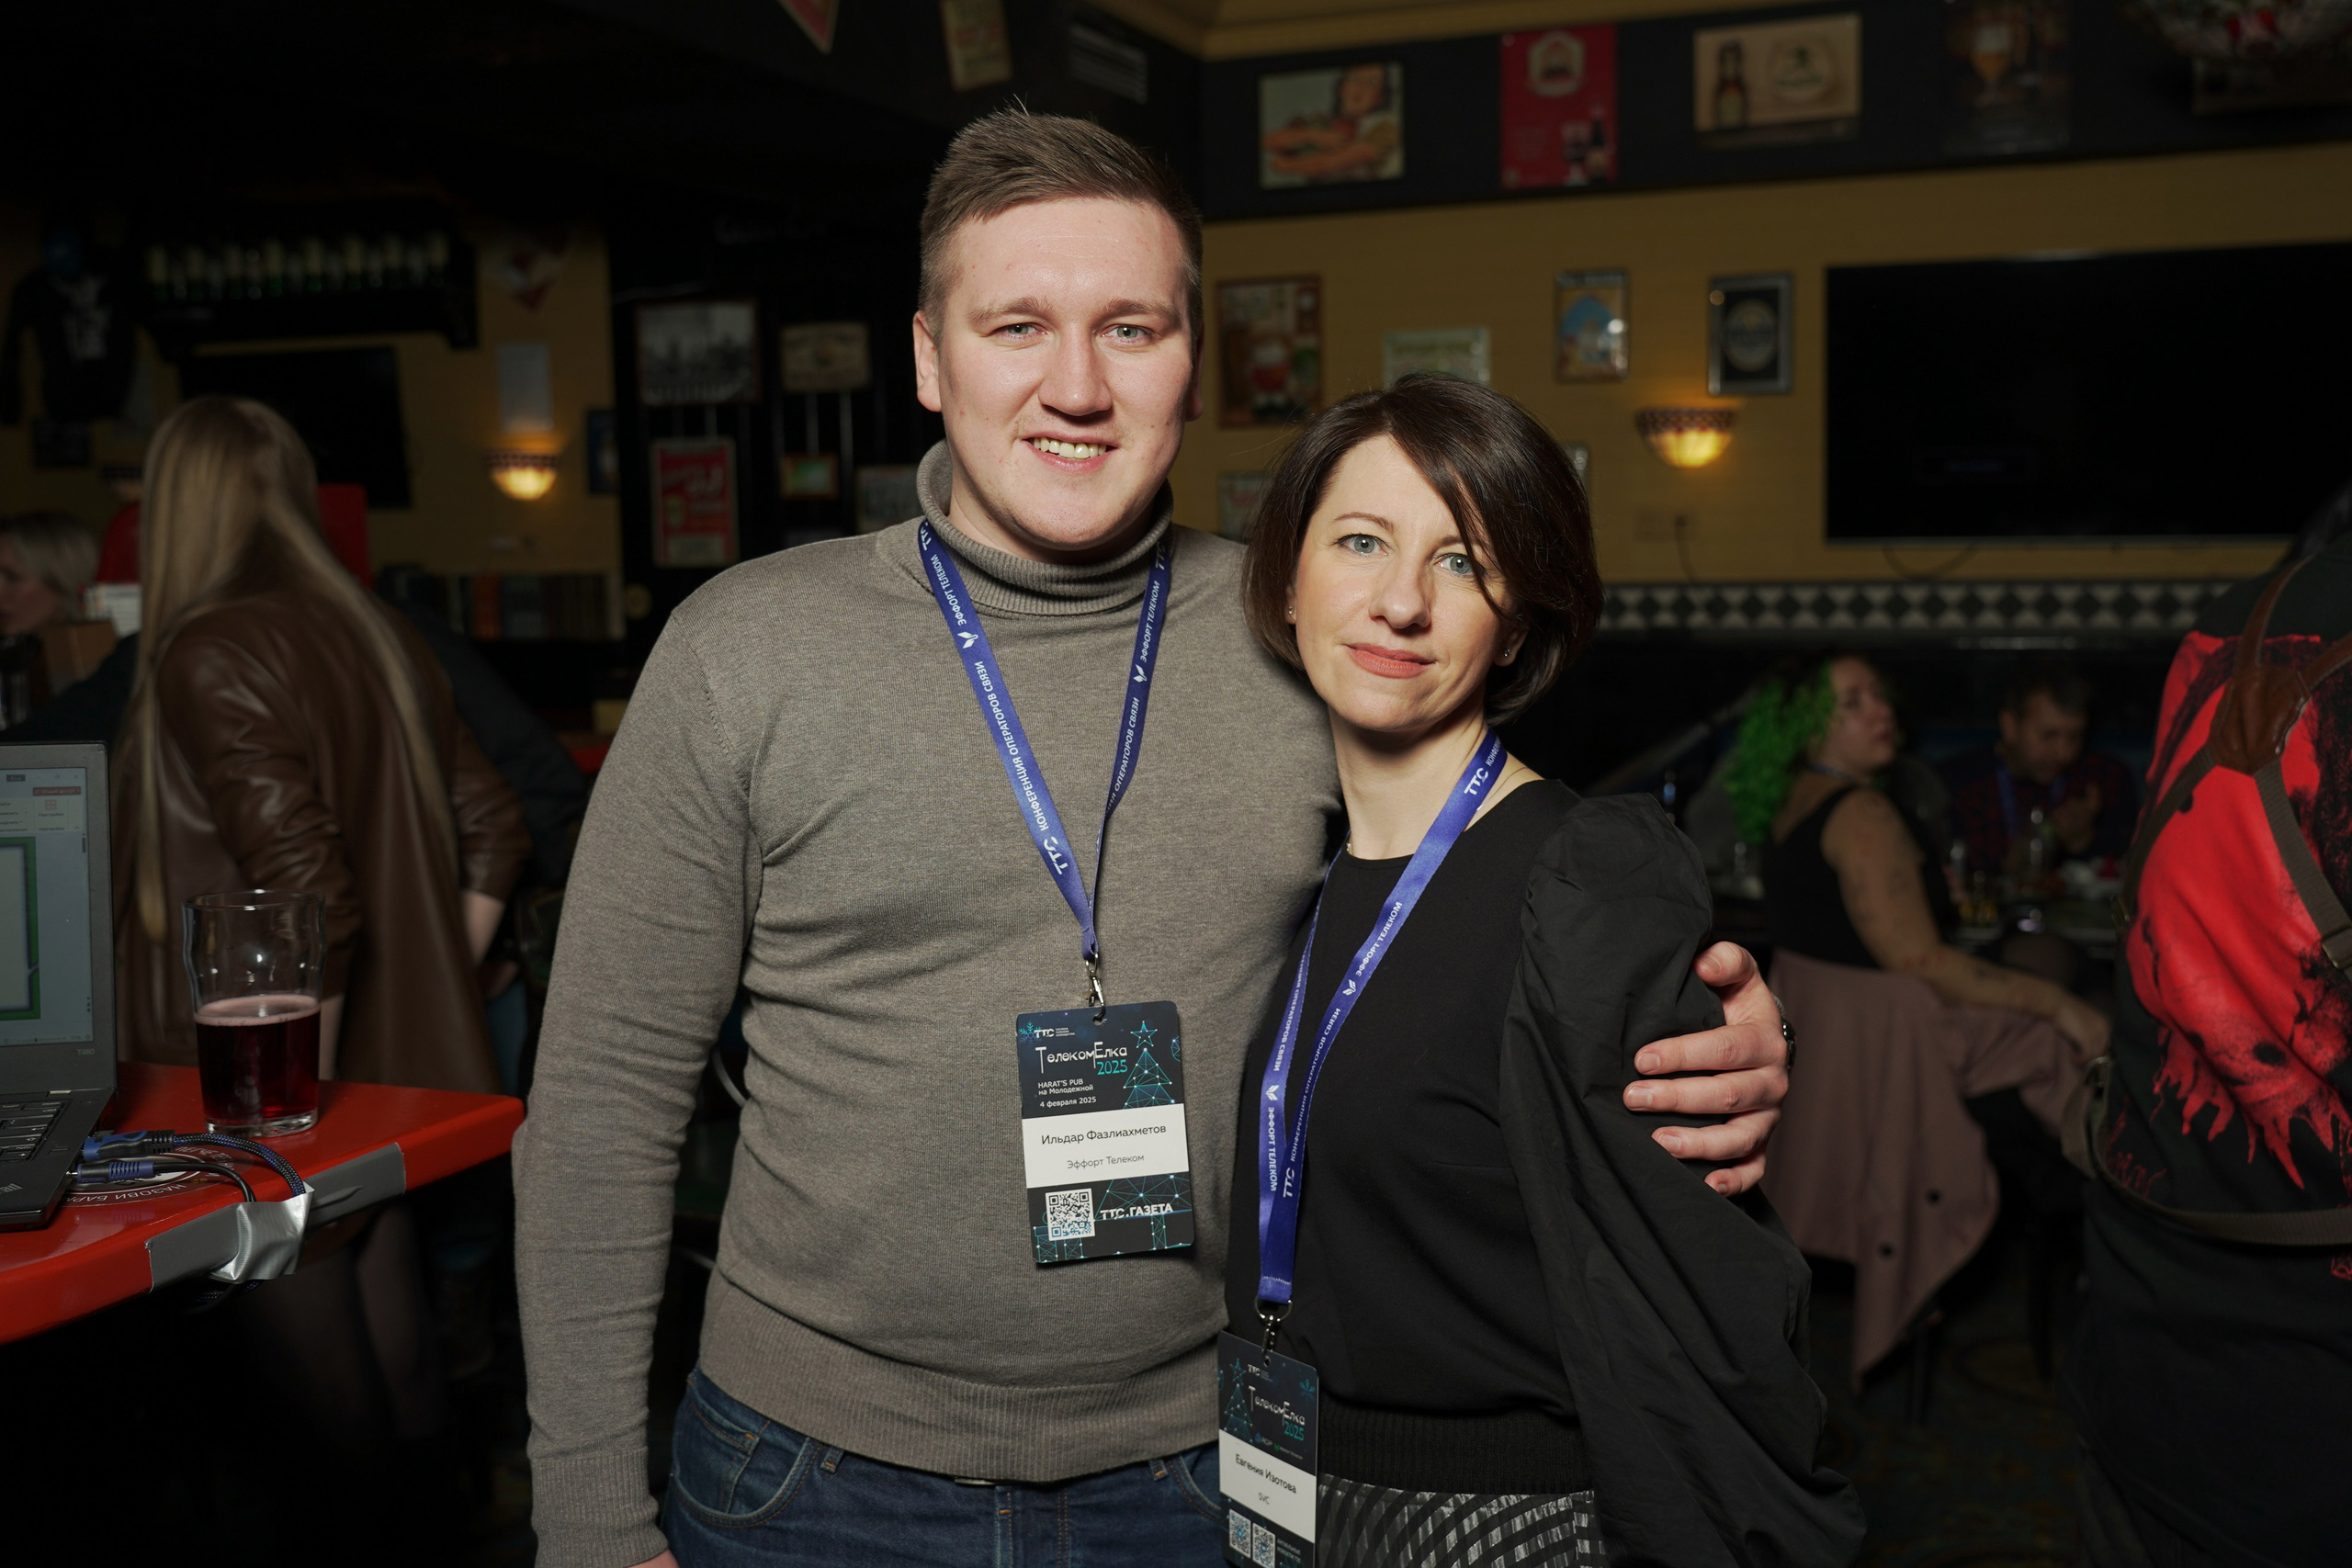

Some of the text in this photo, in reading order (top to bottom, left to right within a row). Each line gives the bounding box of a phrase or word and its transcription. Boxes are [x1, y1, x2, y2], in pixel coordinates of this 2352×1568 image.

[930, 554, 967, 626] ЭФФОРТ ТЕЛЕКОМ
[1140, 581, 1160, 662] ЭФФОРТ ТЕЛЕКОМ
[1114, 696, 1140, 792] ОПЕРАТОРОВ СВЯЗИ
[974, 660, 1069, 875] ТТС КОНФЕРЕНЦИЯ ОПЕРАТОРОВ СВЯЗИ
[1464, 767, 1489, 795] ТТС
[1355, 901, 1403, 976] ЭФФОРТ ТЕЛЕКОМ
[1034, 1028, 1055, 1038] ТТС
[1096, 1059, 1128, 1076] 2025
[1273, 1044, 1285, 1072] СВЯЗИ
[1049, 1084, 1093, 1094] Молодежной
[1290, 1096, 1307, 1162] КОНФЕРЕНЦИЯ
[1306, 1036, 1326, 1094] ОПЕРАТОРОВ
[1324, 1008, 1341, 1036] СВЯЗИ
[1046, 1100, 1077, 1108] февраля
[1079, 1096, 1097, 1104] 2025
[1041, 1124, 1167, 1145] Ильдар Фазлиахметов
[1067, 1155, 1145, 1169] Эффорт Телеком
[1268, 1107, 1278, 1191] ЭФФОРТ ТЕЛЕКОМ
[115, 1183, 187, 1200] НАЗОВИ
[1283, 1420, 1305, 1441] 2025
[1236, 1453, 1263, 1476] Евгения
[1265, 1469, 1296, 1494] Изотова
